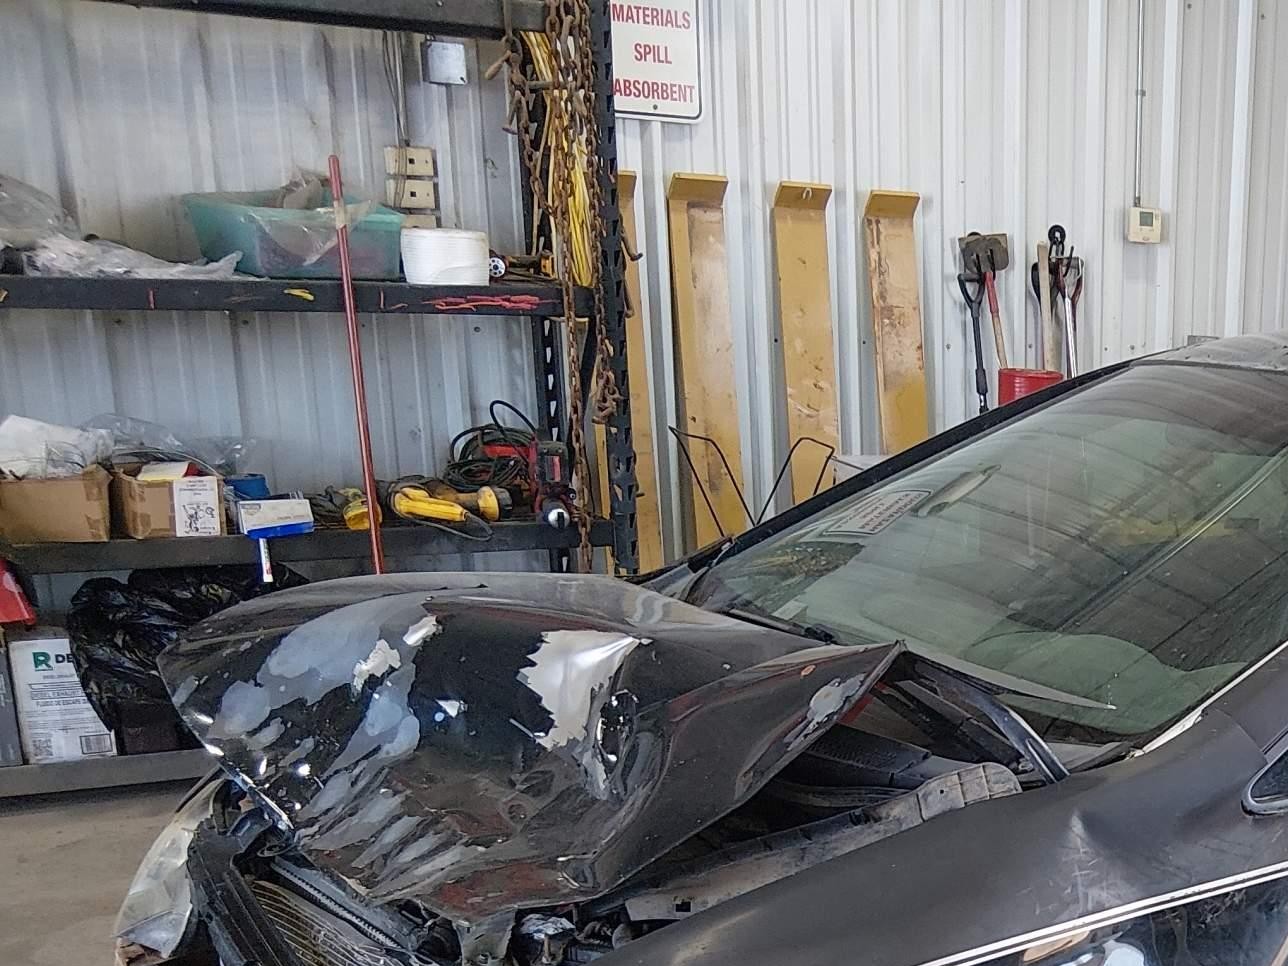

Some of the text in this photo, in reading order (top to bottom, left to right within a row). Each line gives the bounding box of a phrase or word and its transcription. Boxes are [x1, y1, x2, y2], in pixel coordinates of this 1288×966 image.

[612, 3, 691, 29] MATERIALS
[634, 43, 672, 65] SPILL
[613, 78, 695, 103] ABSORBENT
